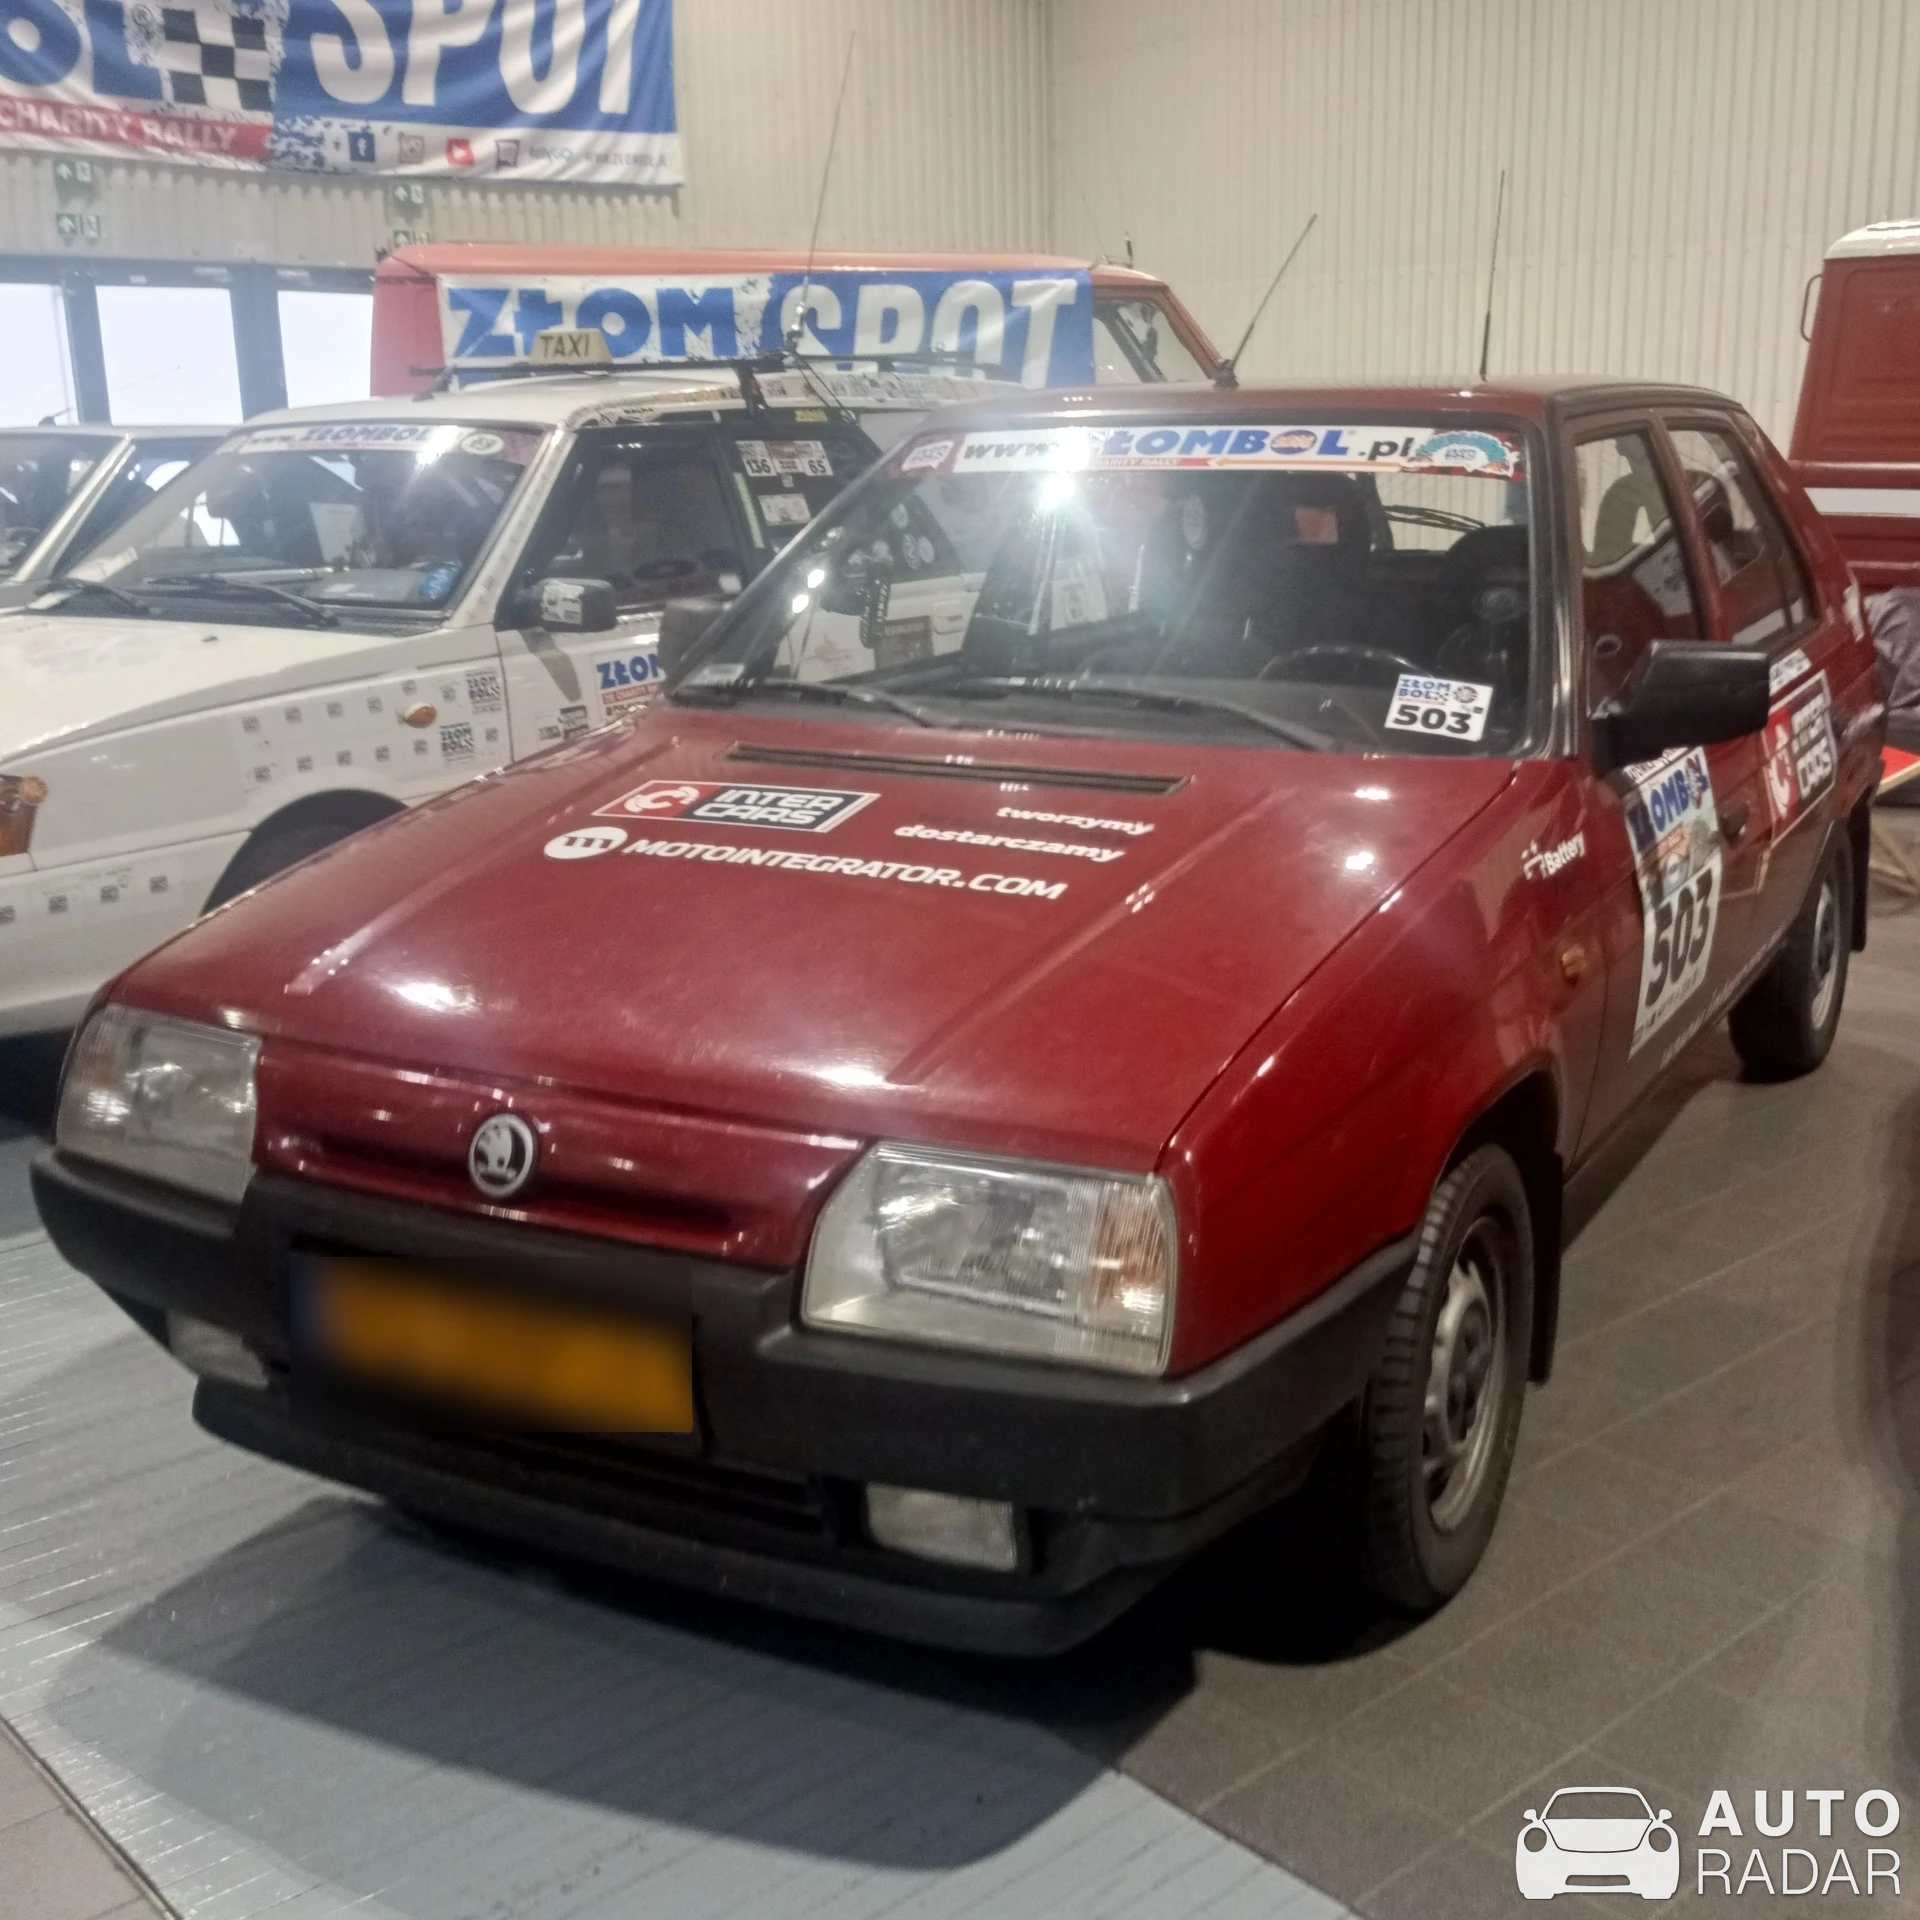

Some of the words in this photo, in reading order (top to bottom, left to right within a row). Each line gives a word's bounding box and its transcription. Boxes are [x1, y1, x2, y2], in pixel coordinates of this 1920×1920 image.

[141, 117, 237, 151] RALLY
[541, 333, 592, 358] TAXI
[780, 279, 1078, 389] SPOT
[747, 459, 771, 474] 136
[808, 459, 826, 474] 65
[1392, 704, 1472, 735] 503
[693, 803, 824, 825] CARS
[713, 789, 844, 811] INTER
[996, 807, 1155, 835] tworzymy
[894, 825, 1125, 862] dostarczamy
[622, 839, 1068, 899] MOTOINTEGRATOR.COM
[1646, 866, 1713, 1007] 503
